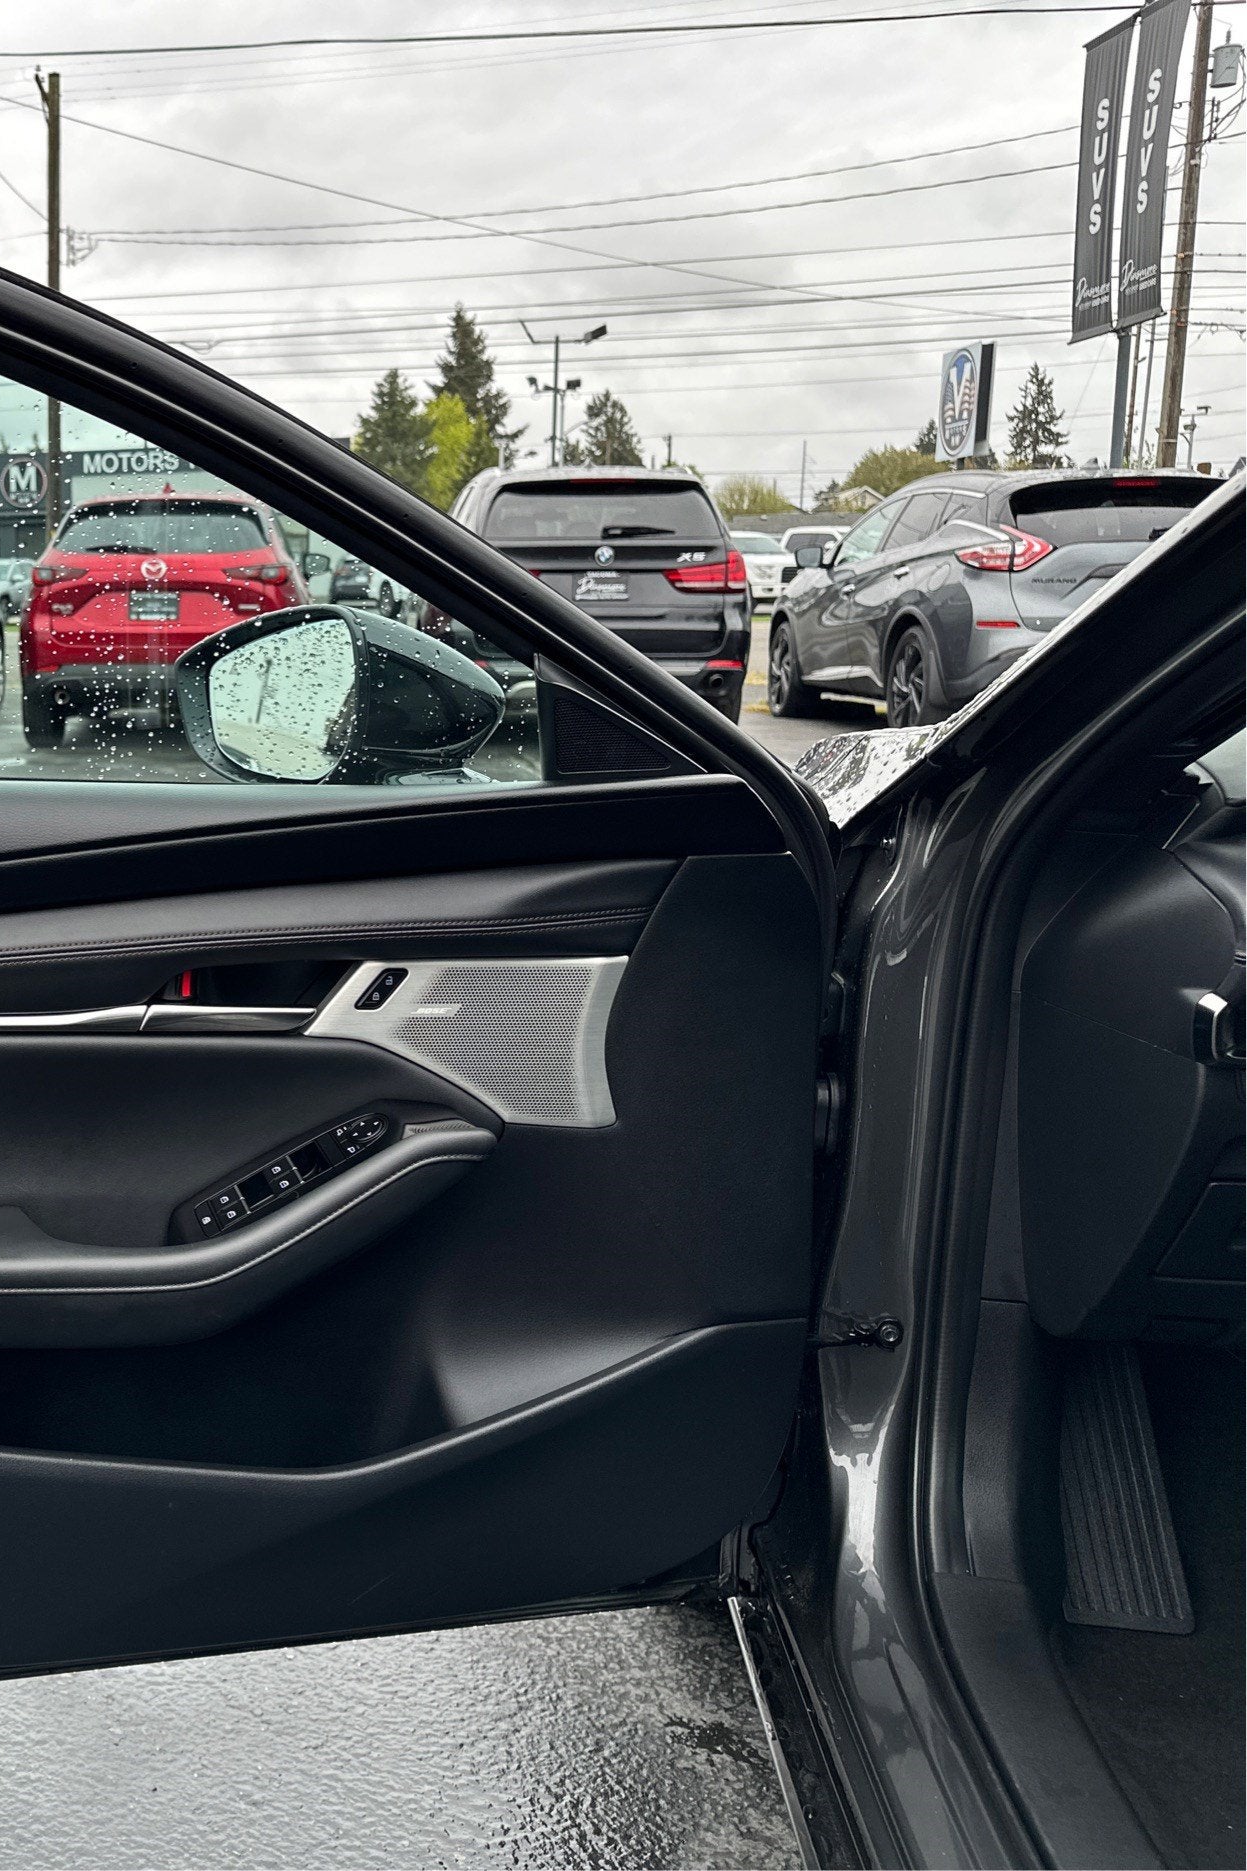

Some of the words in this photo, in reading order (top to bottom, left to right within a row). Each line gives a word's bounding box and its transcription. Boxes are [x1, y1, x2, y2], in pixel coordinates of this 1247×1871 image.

[1137, 68, 1163, 214] SUVS
[1088, 97, 1110, 235] SUVS
[82, 451, 181, 474] MOTORS
[9, 464, 38, 492] M
[411, 1006, 452, 1015] BOSE
